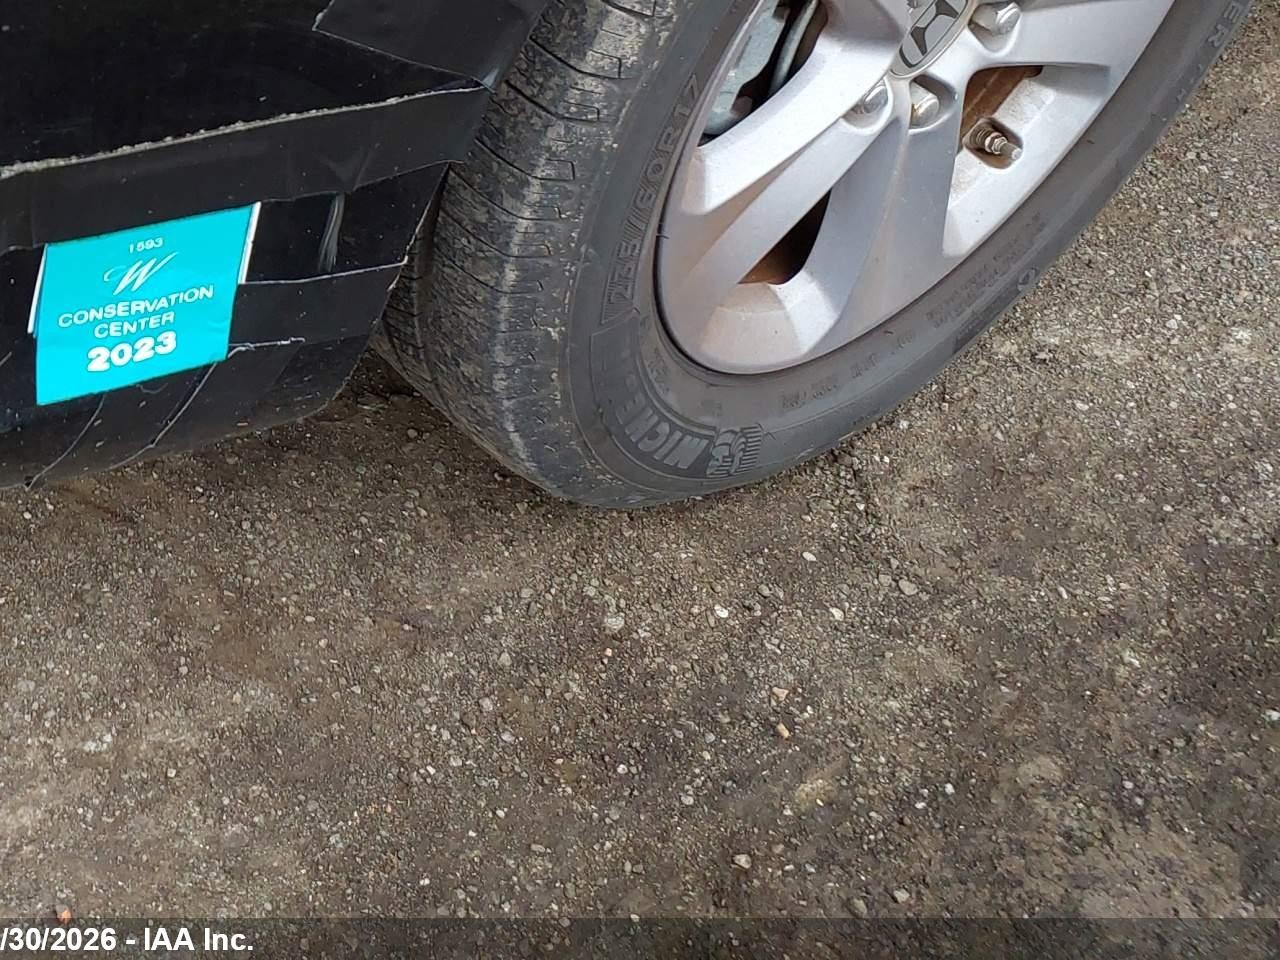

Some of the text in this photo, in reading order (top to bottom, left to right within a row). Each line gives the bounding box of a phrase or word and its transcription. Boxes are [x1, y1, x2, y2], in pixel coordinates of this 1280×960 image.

[57, 285, 215, 328] CONSERVATION
[93, 311, 175, 339] CENTER
[86, 330, 177, 372] 2023
